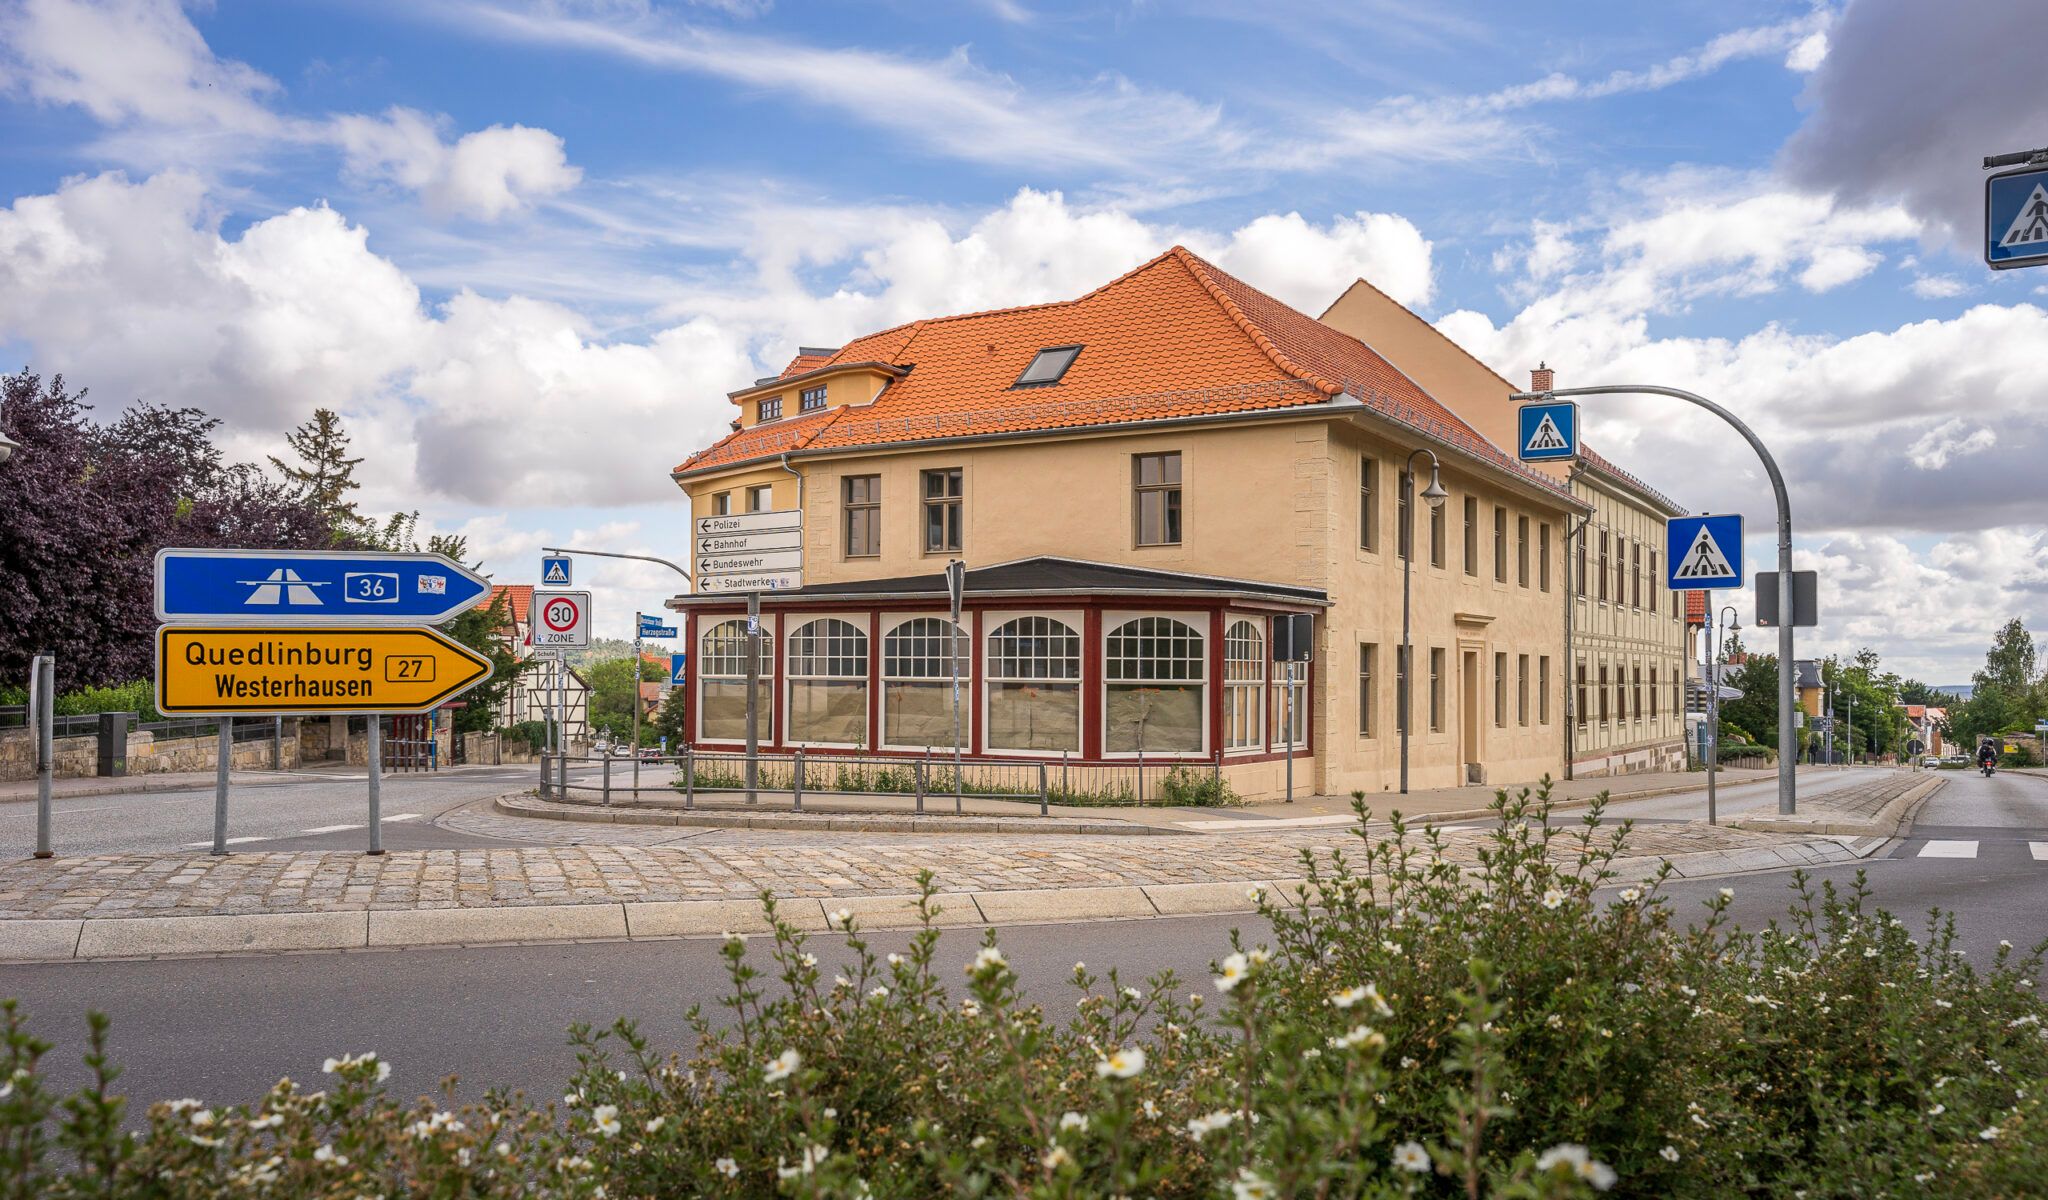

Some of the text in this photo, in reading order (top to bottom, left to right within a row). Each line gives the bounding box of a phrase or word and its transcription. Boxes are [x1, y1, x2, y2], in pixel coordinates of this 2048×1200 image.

[713, 519, 740, 529] Polizei
[714, 538, 747, 549] Bahnhof
[713, 558, 764, 569] Bundeswehr
[359, 579, 385, 597] 36
[724, 577, 770, 588] Stadtwerke
[550, 607, 572, 623] 30
[547, 634, 575, 643] ZONE
[641, 628, 675, 638] Herzogstraße
[185, 641, 373, 670] Quedlinburg
[398, 660, 423, 678] 27
[215, 674, 373, 698] Westerhausen
